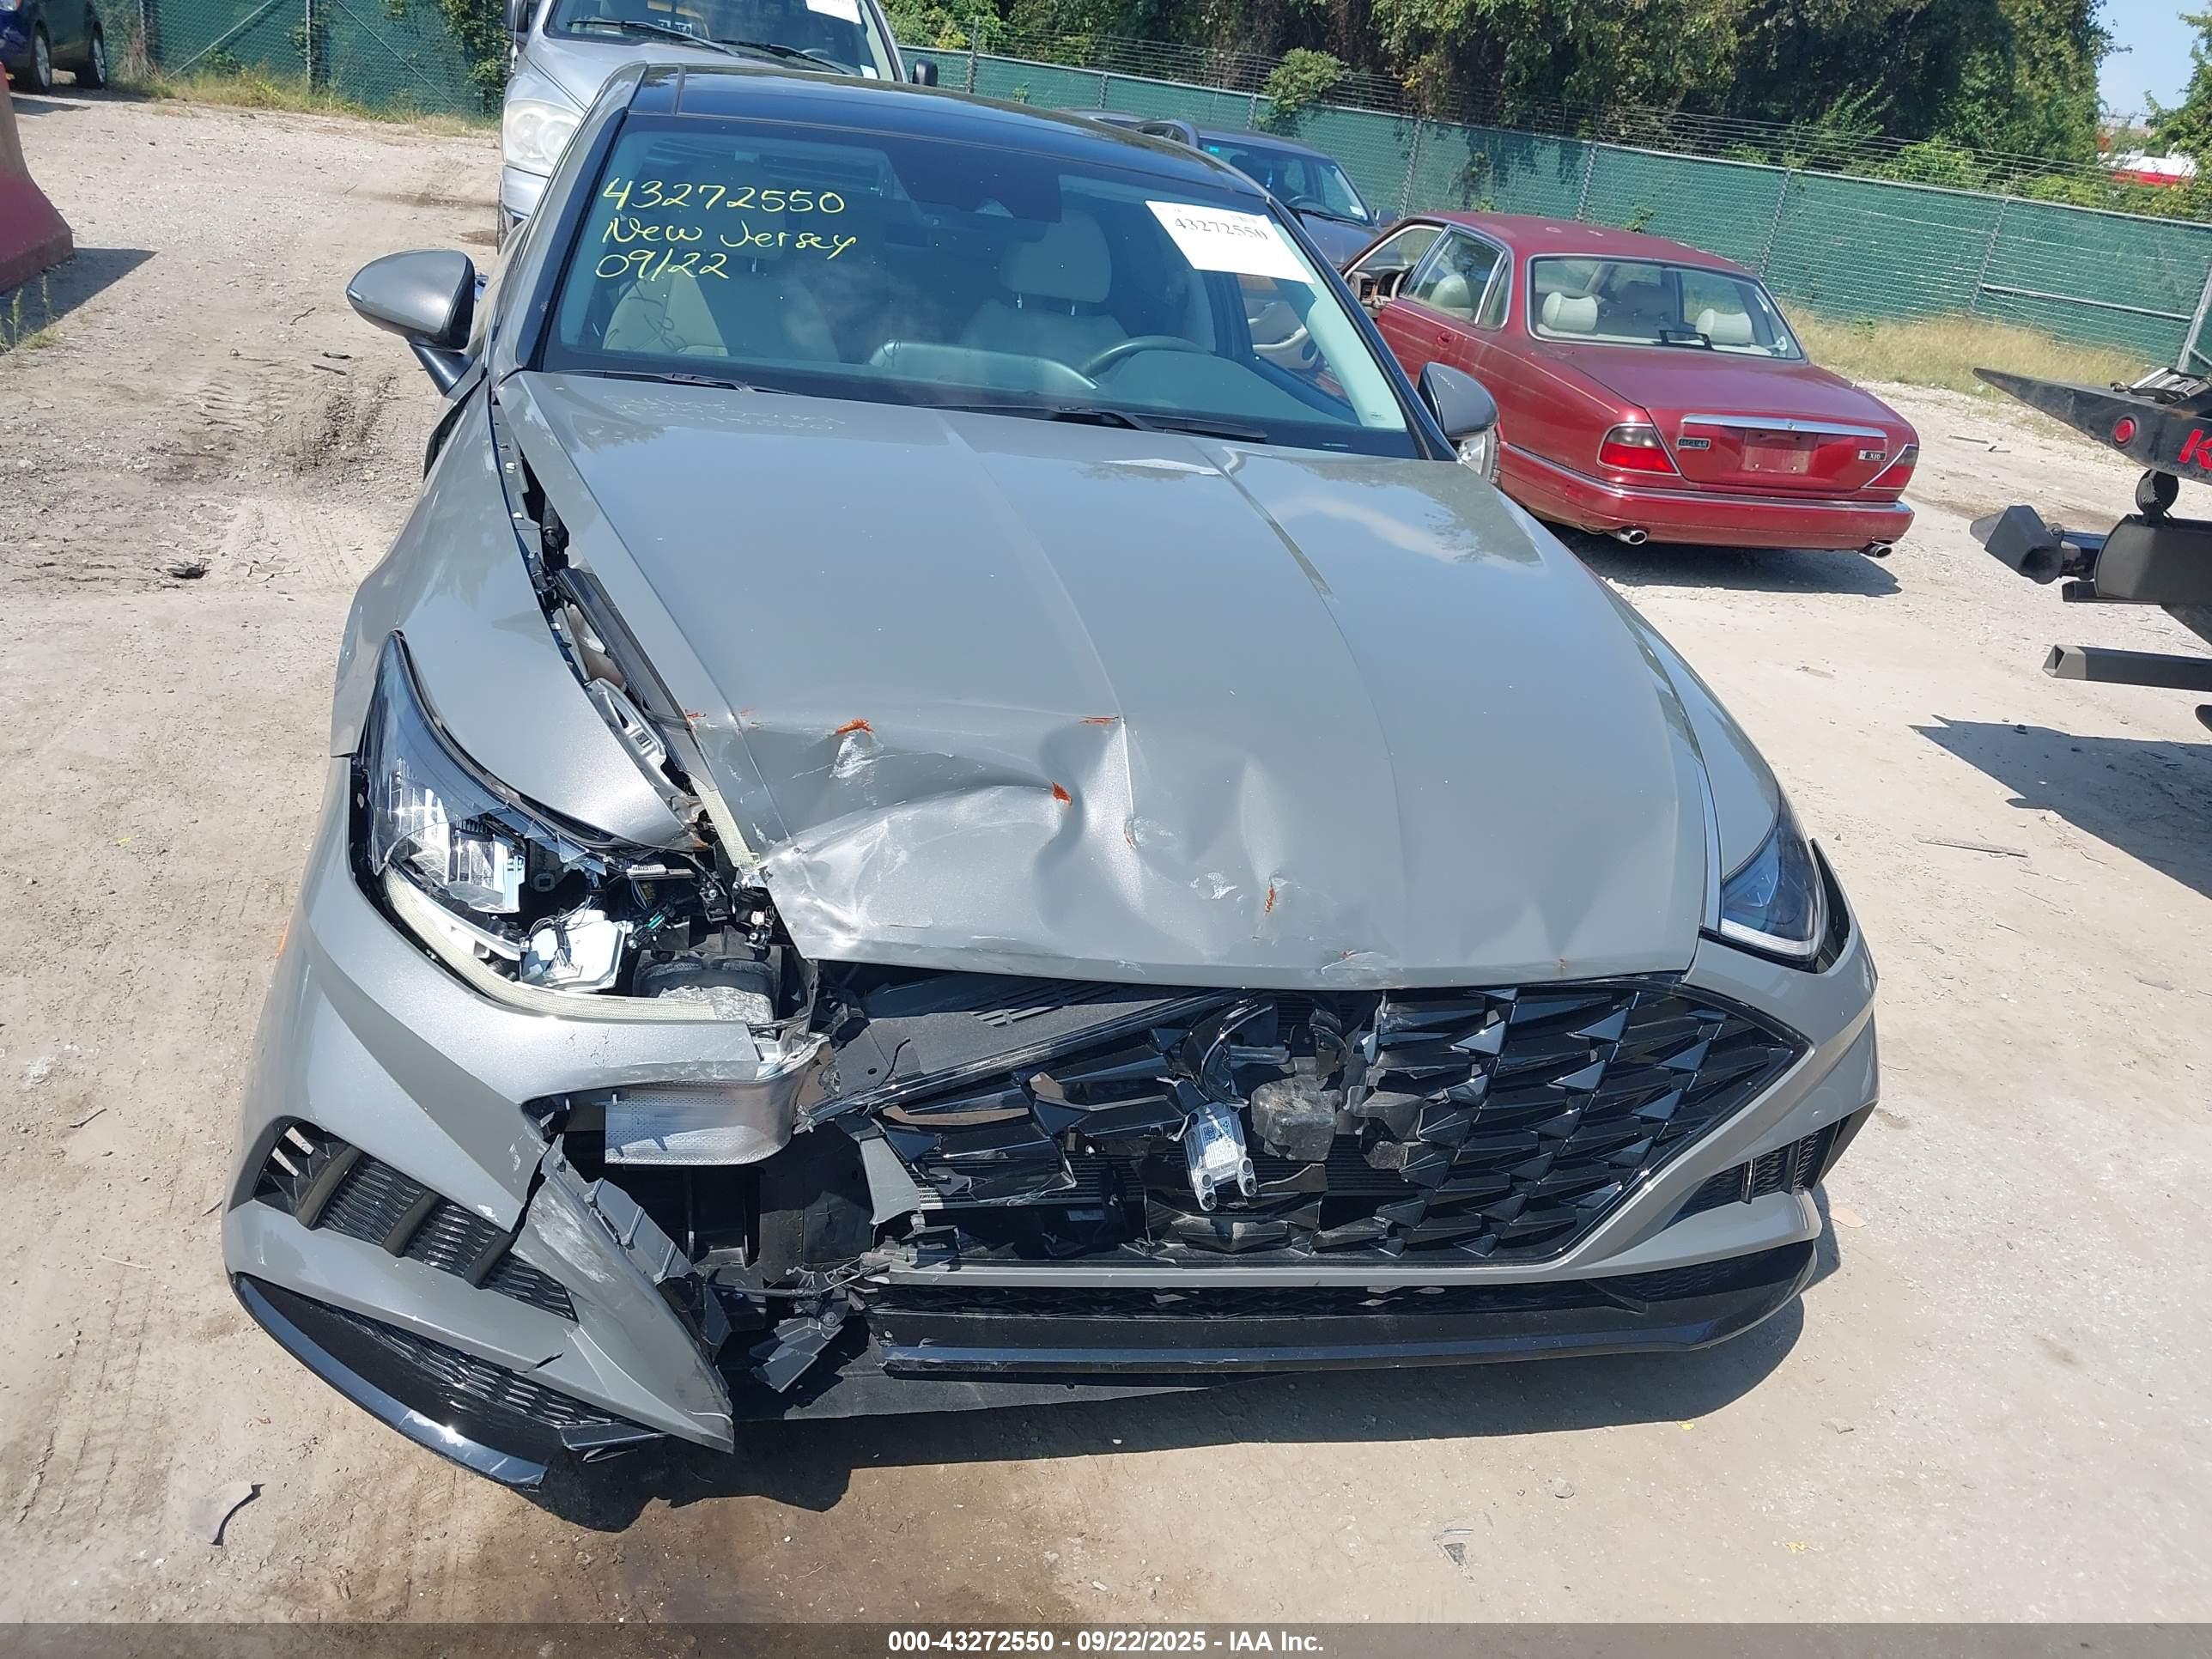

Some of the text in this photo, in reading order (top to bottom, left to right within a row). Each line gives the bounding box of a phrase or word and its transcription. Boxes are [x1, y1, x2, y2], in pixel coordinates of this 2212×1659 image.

[603, 177, 845, 213] 43272550
[603, 216, 858, 260] New Jersey
[595, 249, 730, 283] 09/22
